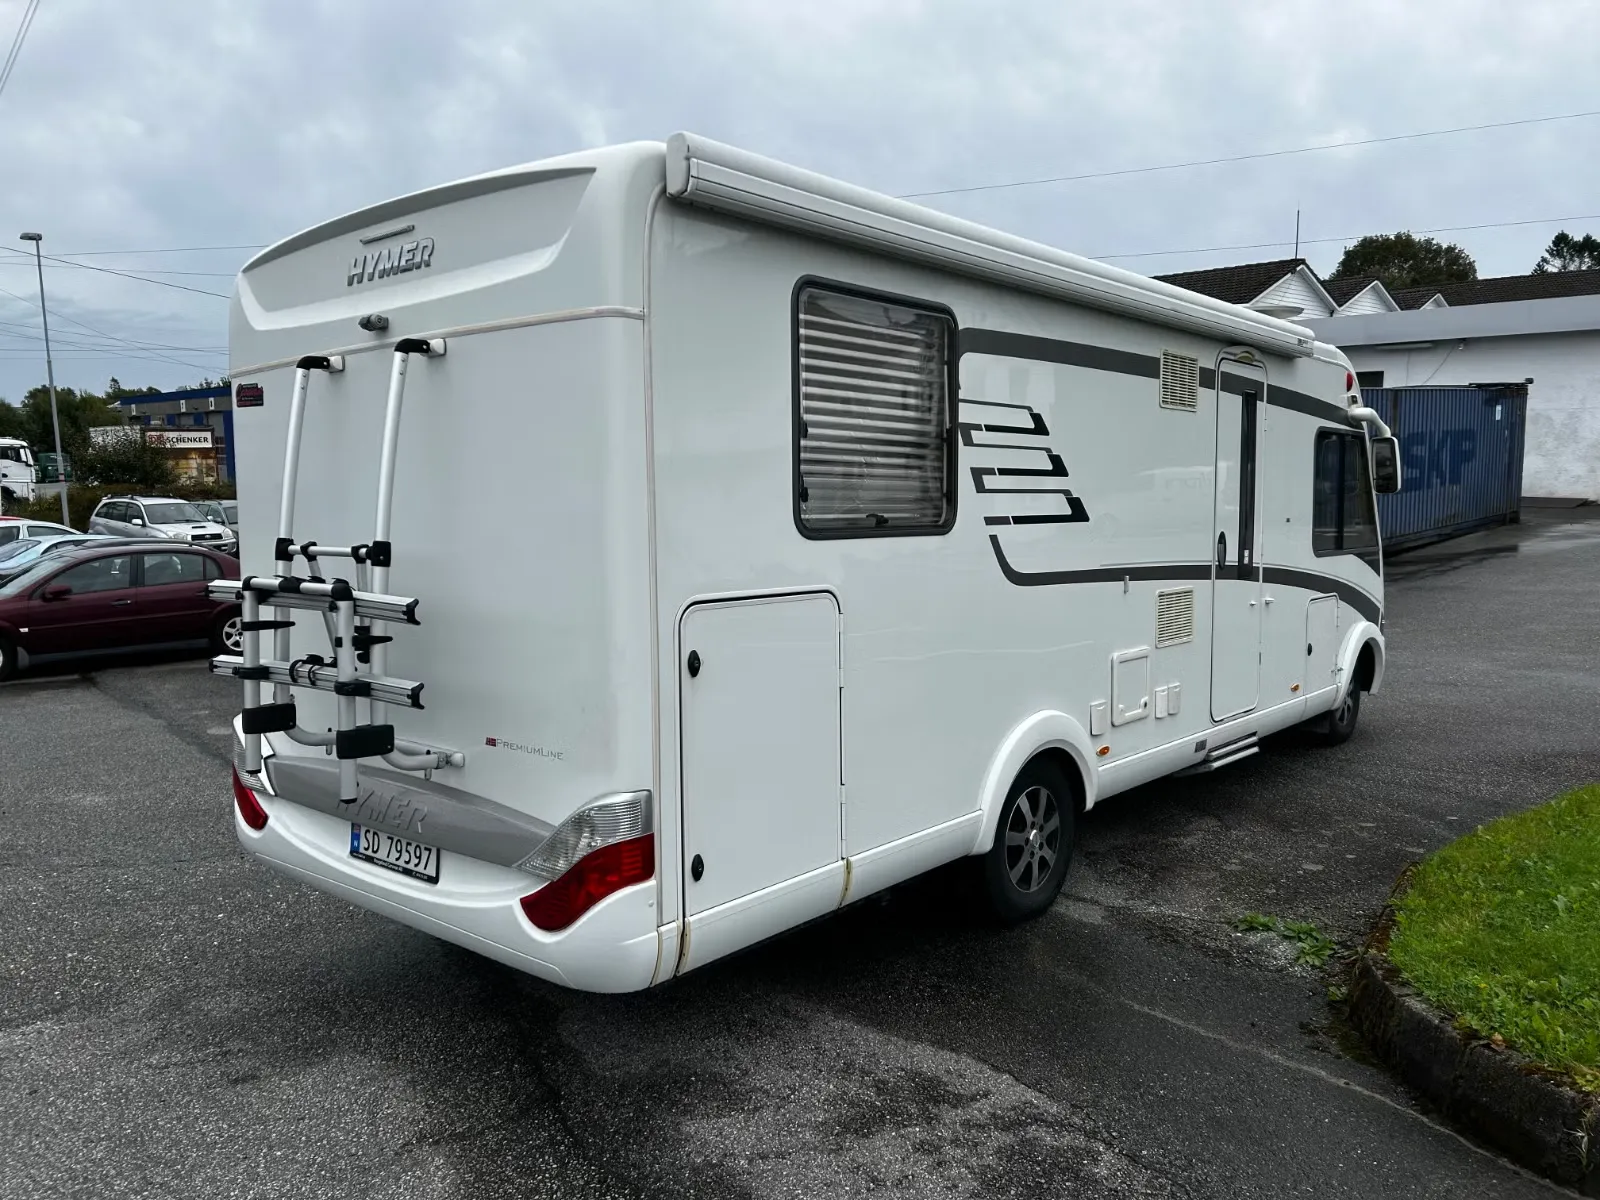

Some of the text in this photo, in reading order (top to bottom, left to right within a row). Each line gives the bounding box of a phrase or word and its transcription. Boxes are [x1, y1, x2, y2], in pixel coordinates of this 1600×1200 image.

[347, 237, 434, 286] HYMER
[167, 436, 208, 444] SCHENKER
[336, 787, 428, 833] YMER
[363, 828, 381, 854] SD
[386, 836, 432, 870] 79597
